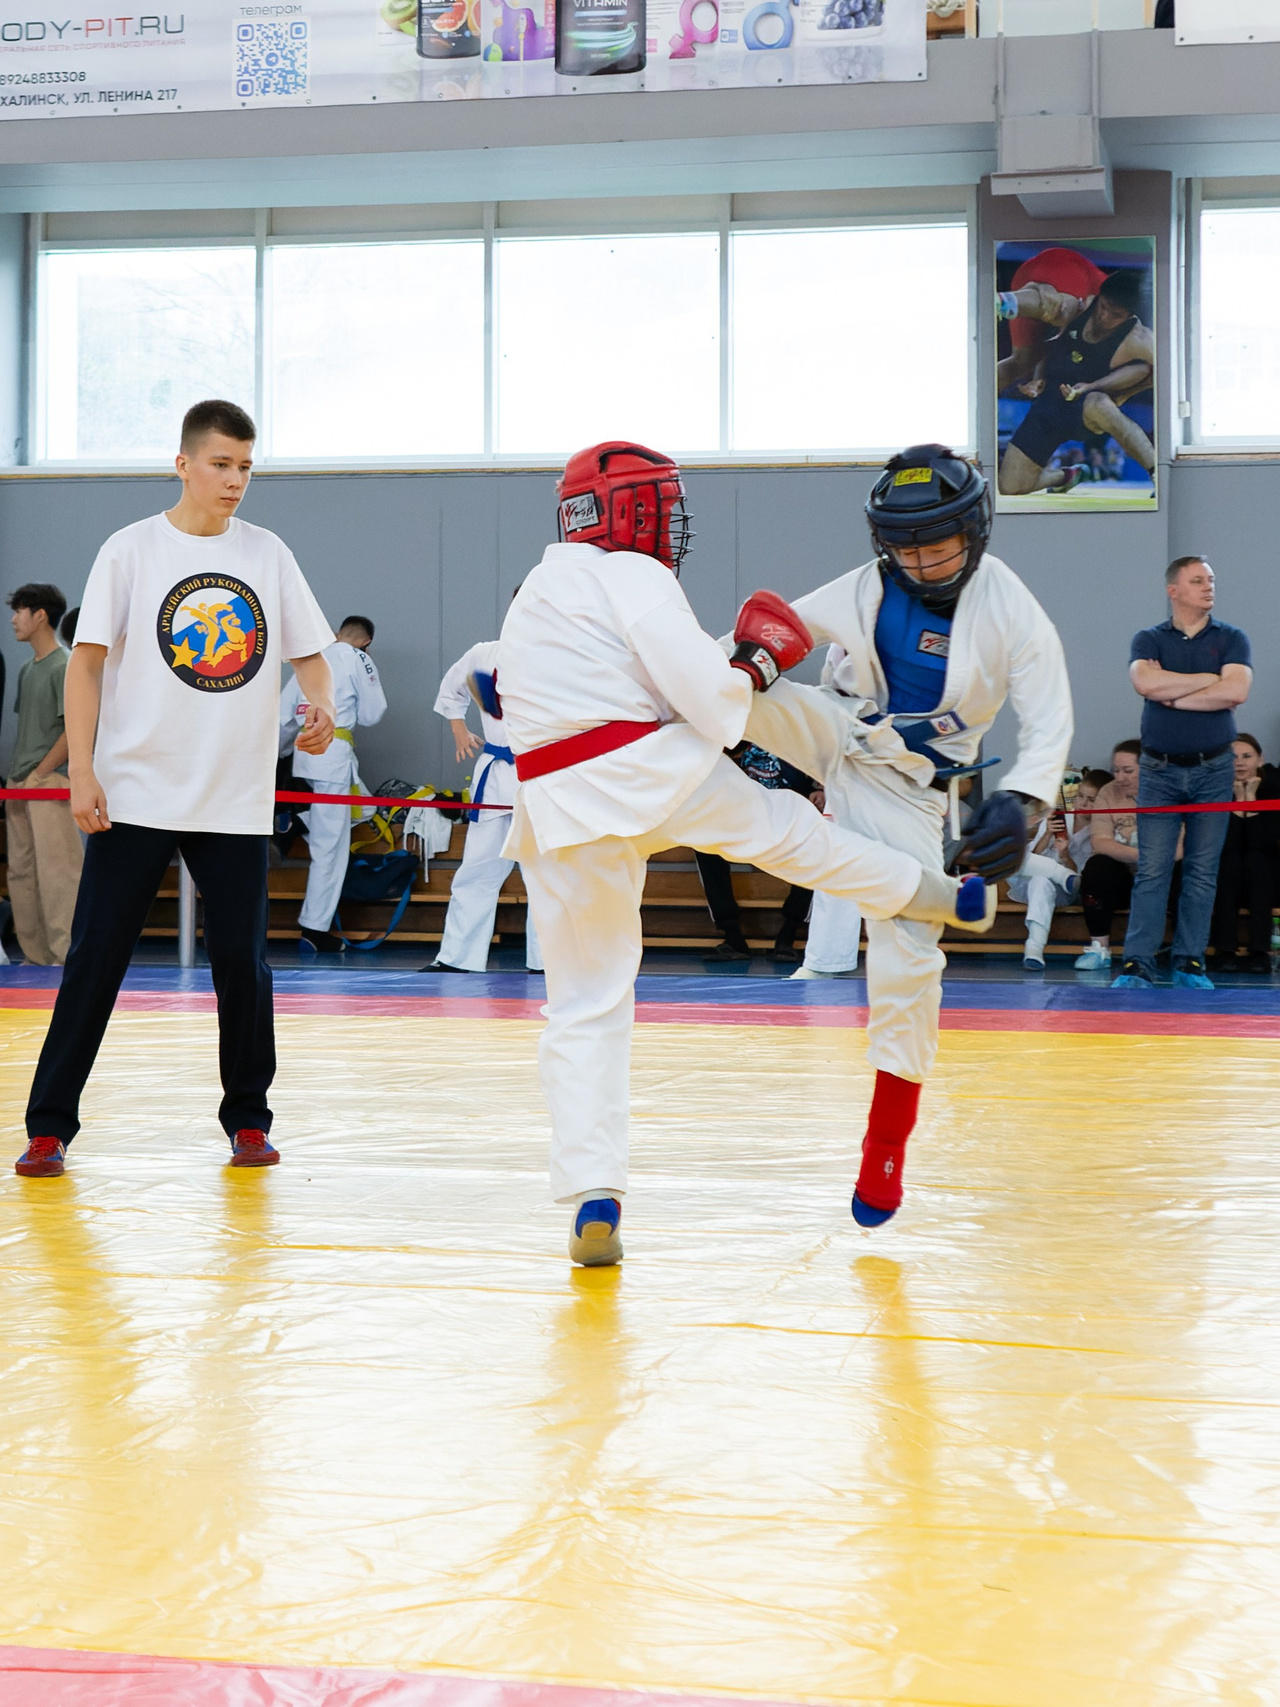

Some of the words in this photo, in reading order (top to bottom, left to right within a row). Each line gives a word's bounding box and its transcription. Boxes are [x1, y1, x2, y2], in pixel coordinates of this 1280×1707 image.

[239, 5, 303, 16] телеграм
[73, 92, 94, 104] УЛ.
[98, 90, 153, 102] ЛЕНИНА
[157, 88, 178, 101] 217
[161, 578, 202, 634] АРМЕЙСКИЙ
[202, 577, 265, 629] РУКОПАШНЫЙ
[255, 631, 265, 655] БОЙ
[195, 673, 245, 689] САХАЛИН
